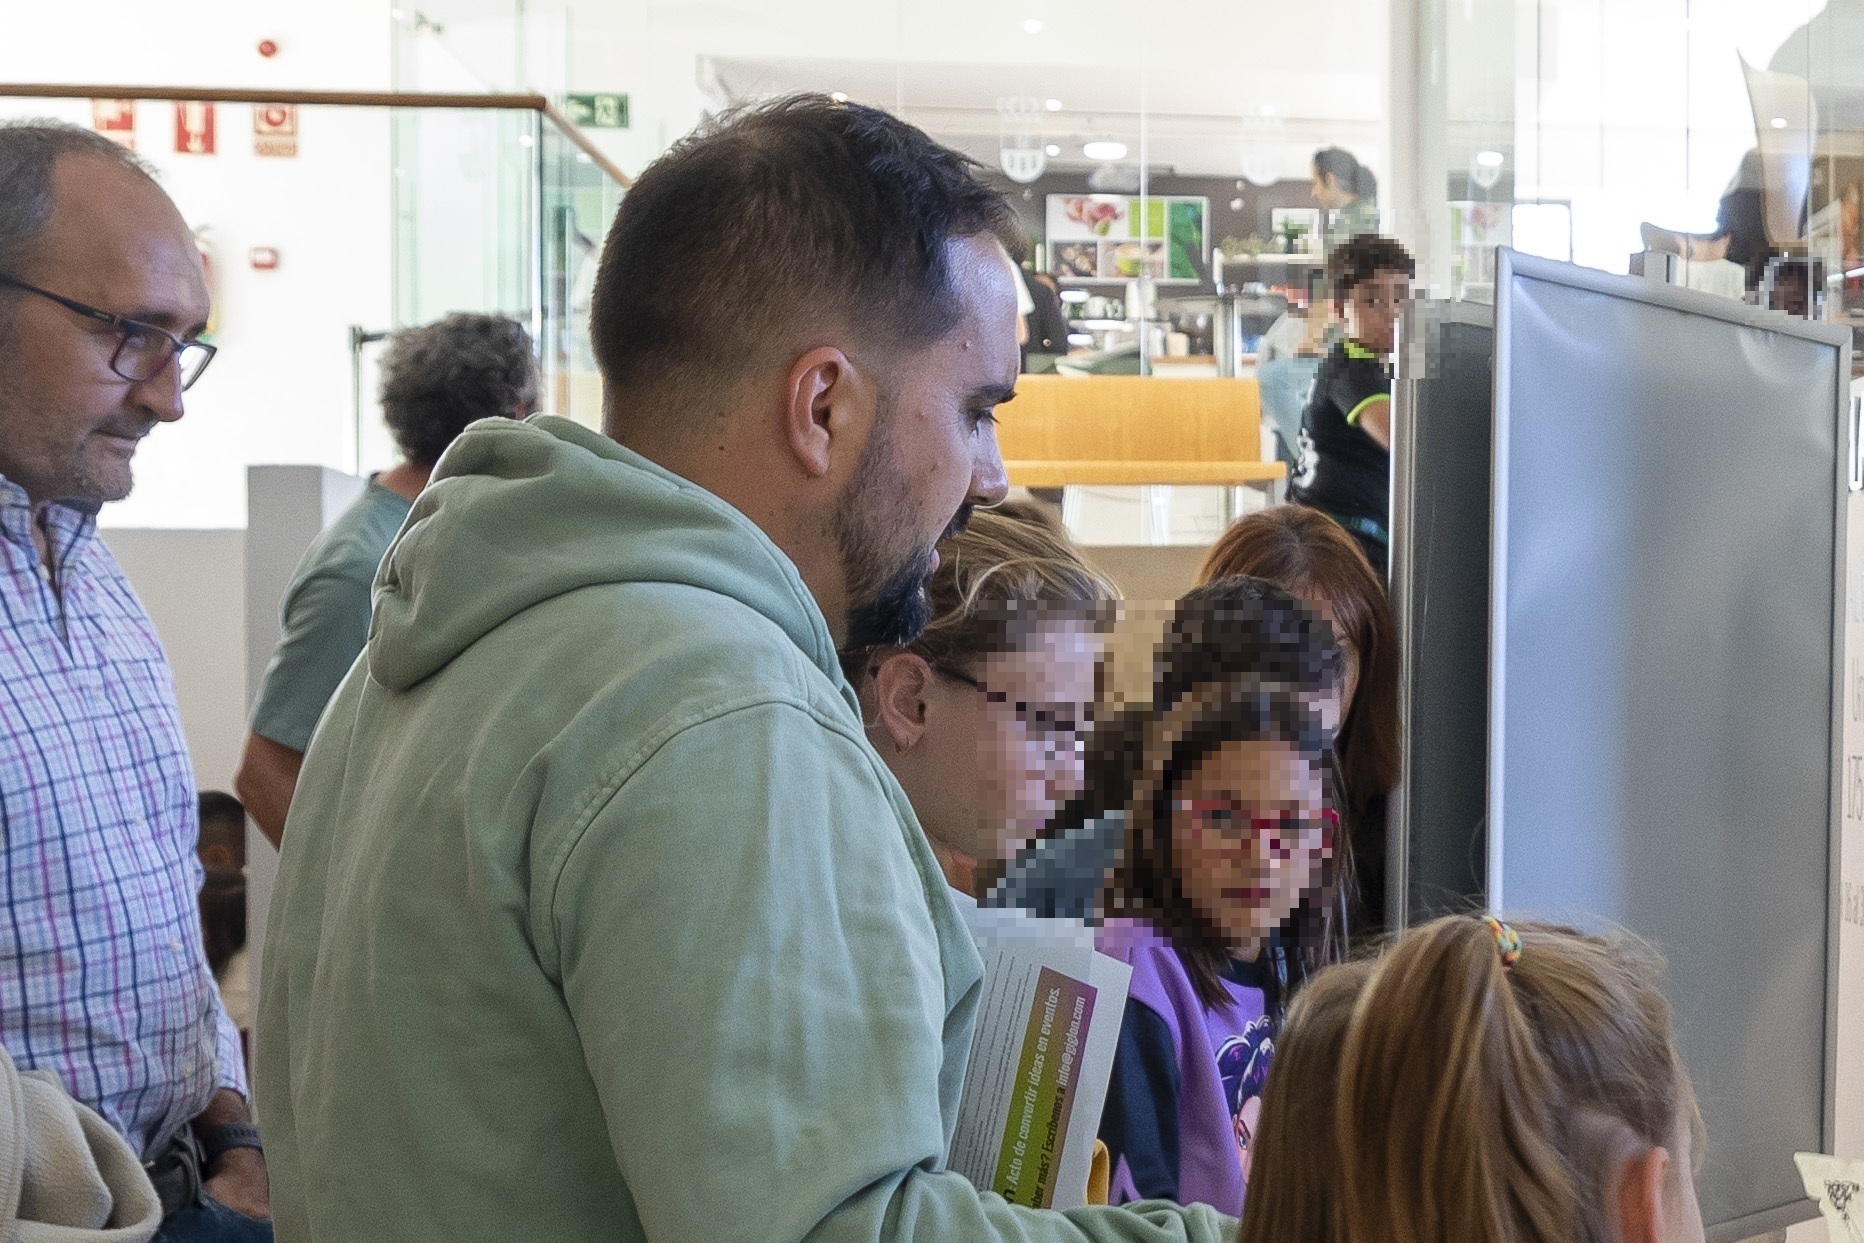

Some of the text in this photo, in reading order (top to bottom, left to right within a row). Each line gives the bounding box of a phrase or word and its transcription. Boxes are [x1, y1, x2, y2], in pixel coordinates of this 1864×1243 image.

[1847, 756, 1863, 820] 175
[1040, 987, 1060, 1036] eventos.
[1037, 1037, 1049, 1052] en
[1027, 1053, 1045, 1087] ideas
[1019, 1086, 1038, 1140] convertir
[1012, 1140, 1026, 1157] de
[1006, 1157, 1022, 1185] Acto
